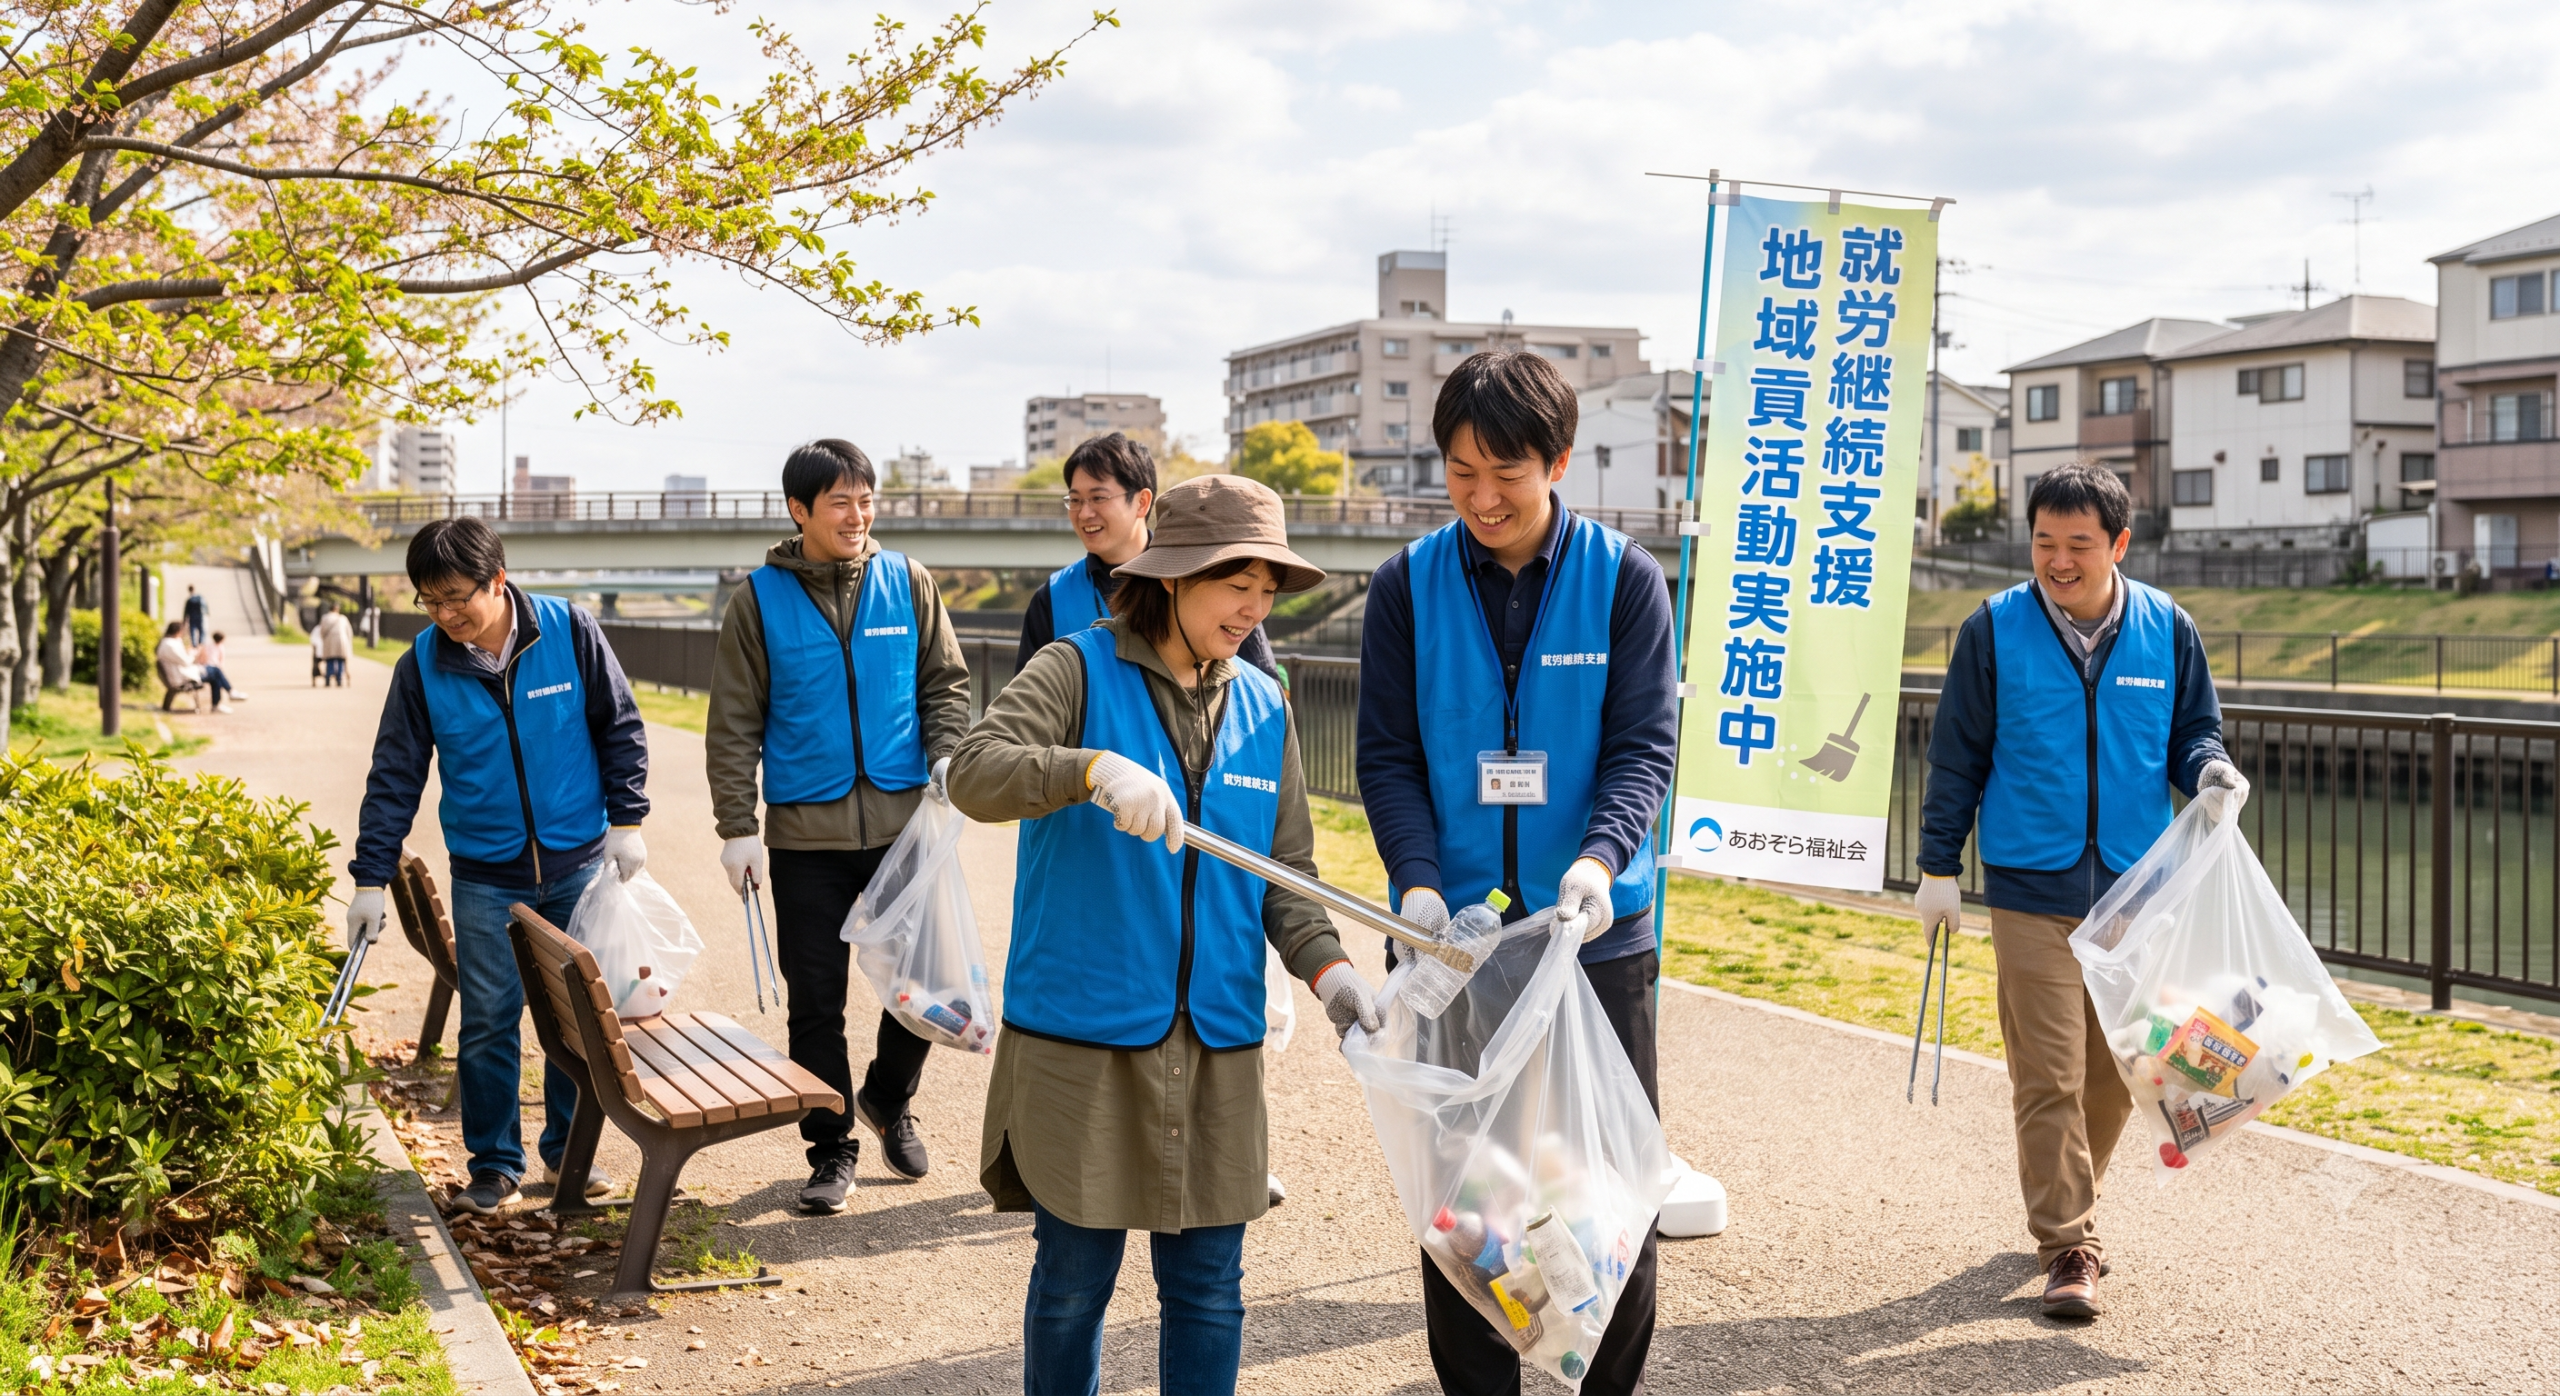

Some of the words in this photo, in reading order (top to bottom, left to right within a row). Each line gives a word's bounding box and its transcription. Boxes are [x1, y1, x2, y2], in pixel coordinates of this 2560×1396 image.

[1718, 227, 1823, 765] 地域貢活動実施中
[1810, 226, 1903, 609] 就労継続支援
[1728, 829, 1868, 862] あおぞら福祉会
